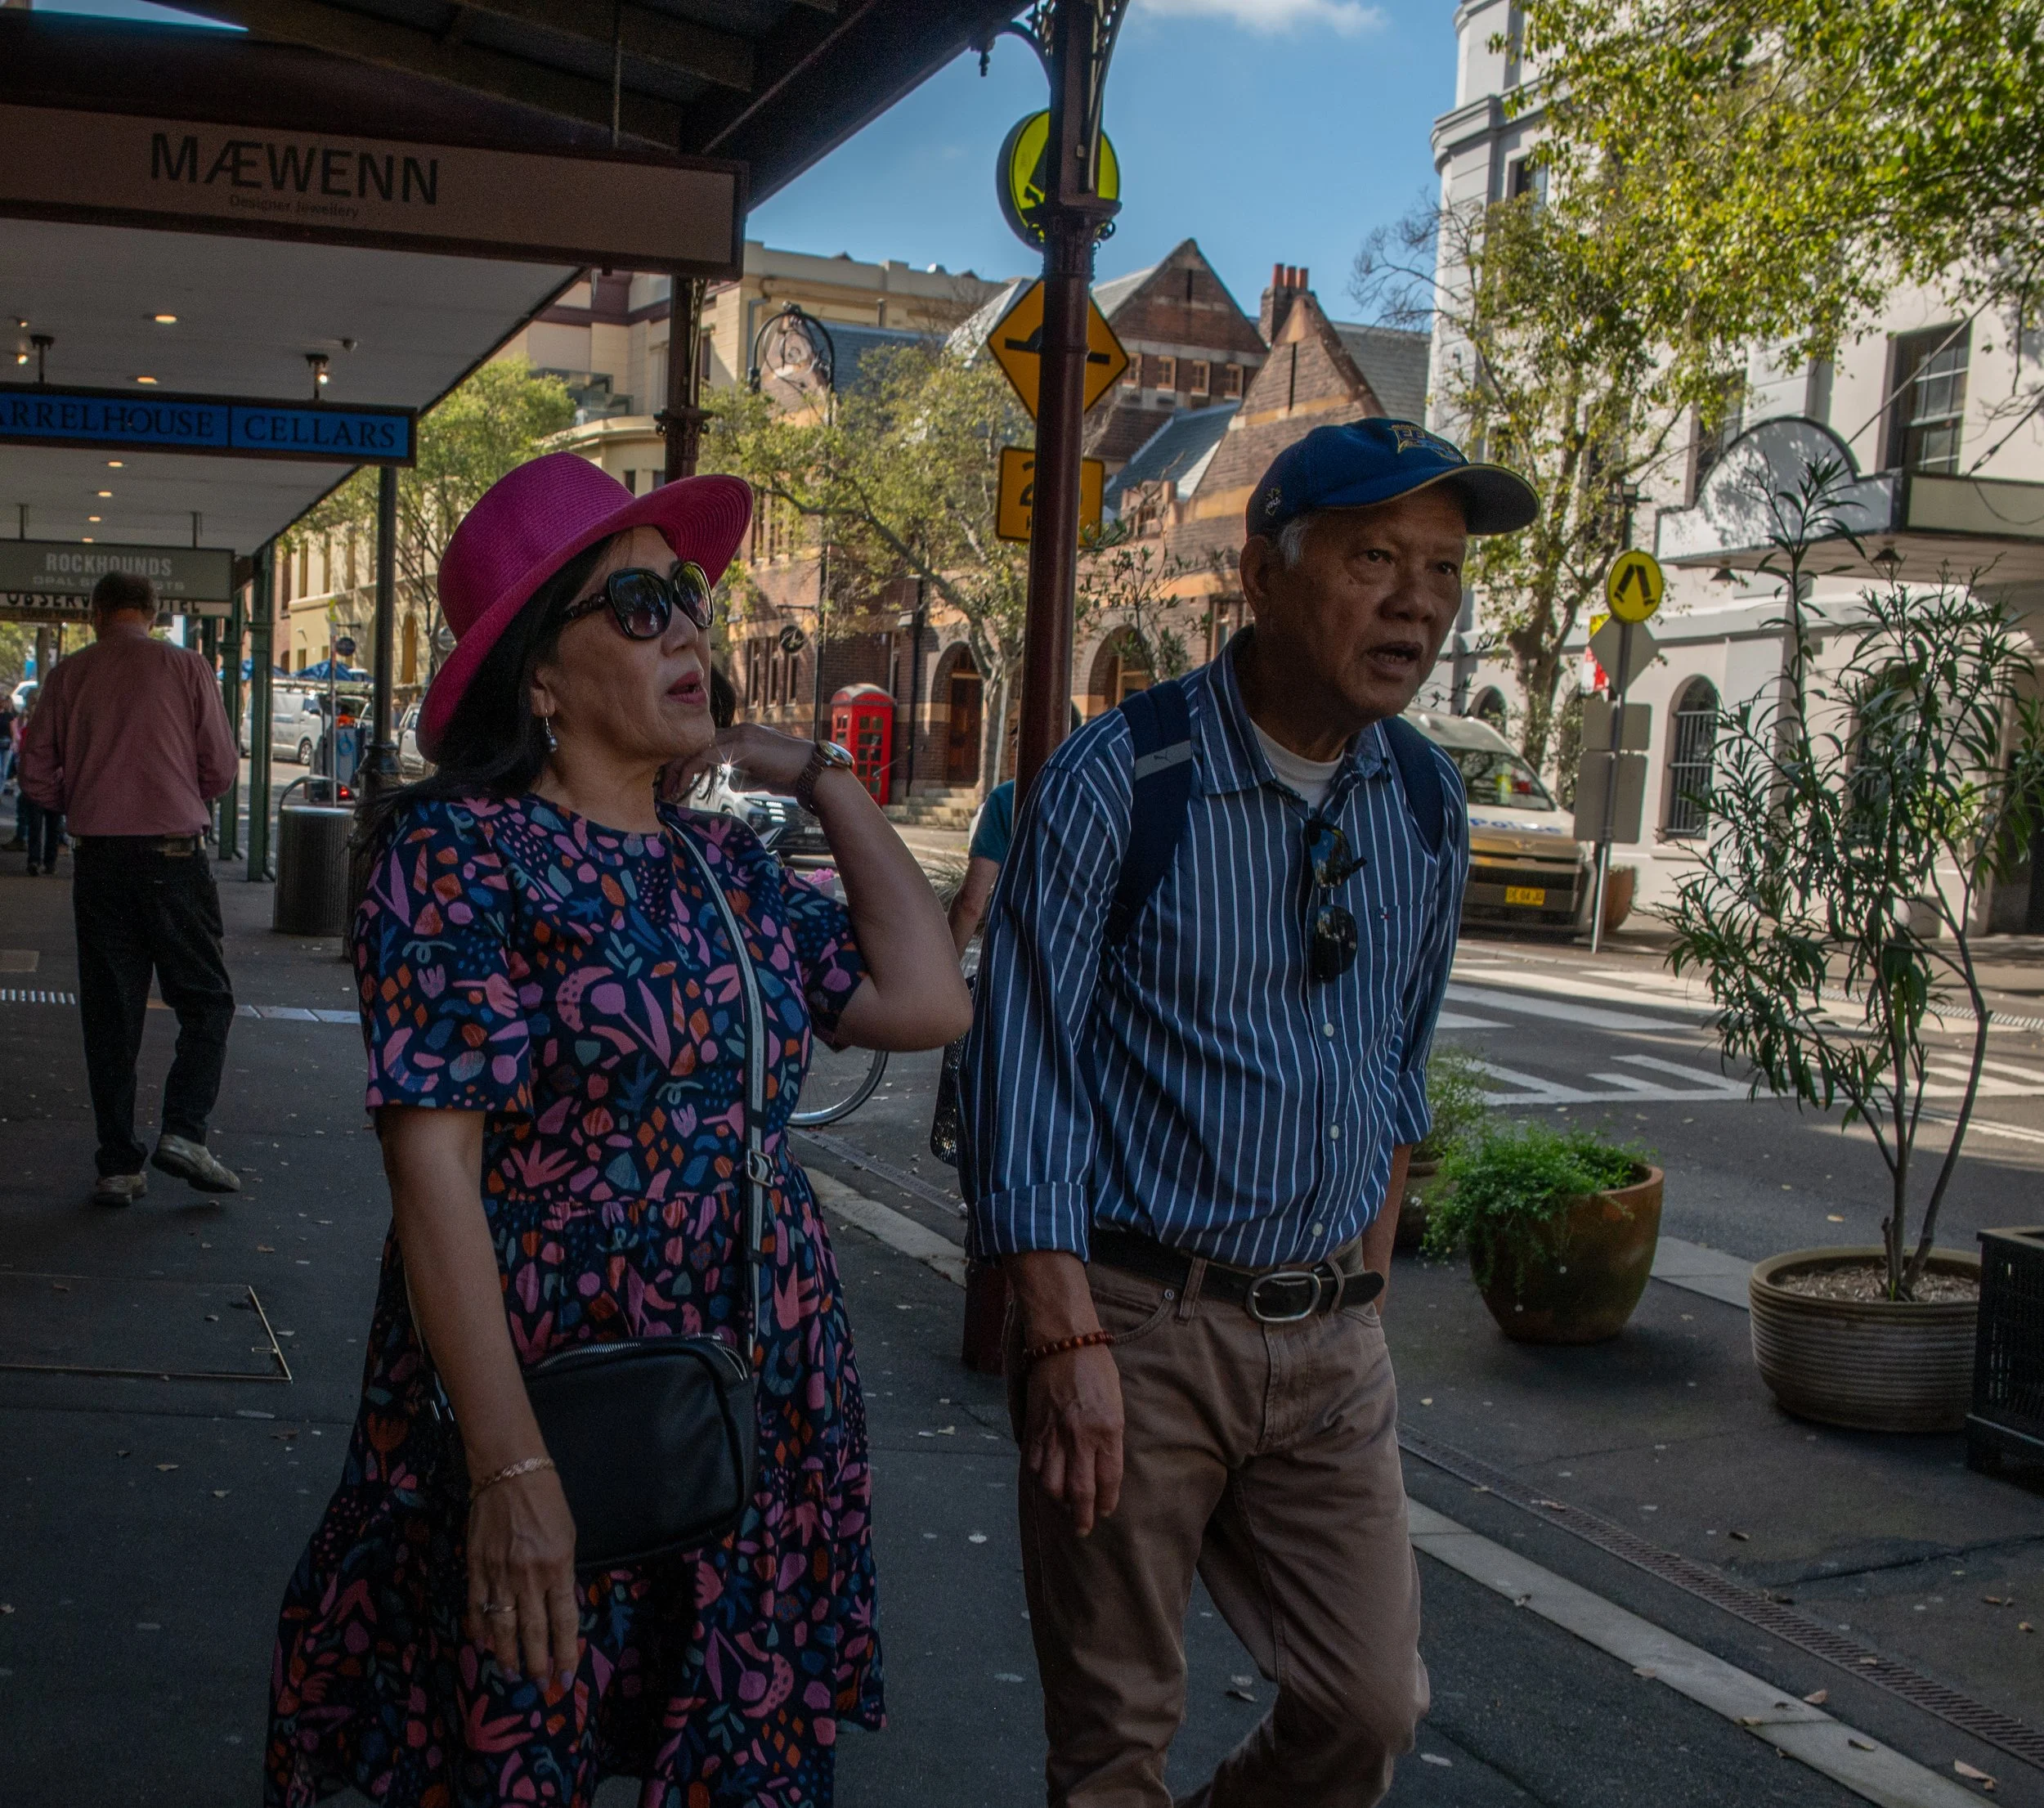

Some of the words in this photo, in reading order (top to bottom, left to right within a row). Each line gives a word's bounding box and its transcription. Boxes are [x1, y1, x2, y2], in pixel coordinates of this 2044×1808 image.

[151, 132, 438, 206] MÆWENN
[230, 194, 290, 213] Designer
[244, 414, 396, 449] CELLARS
[45, 553, 172, 576] ROCKHOUNDS
